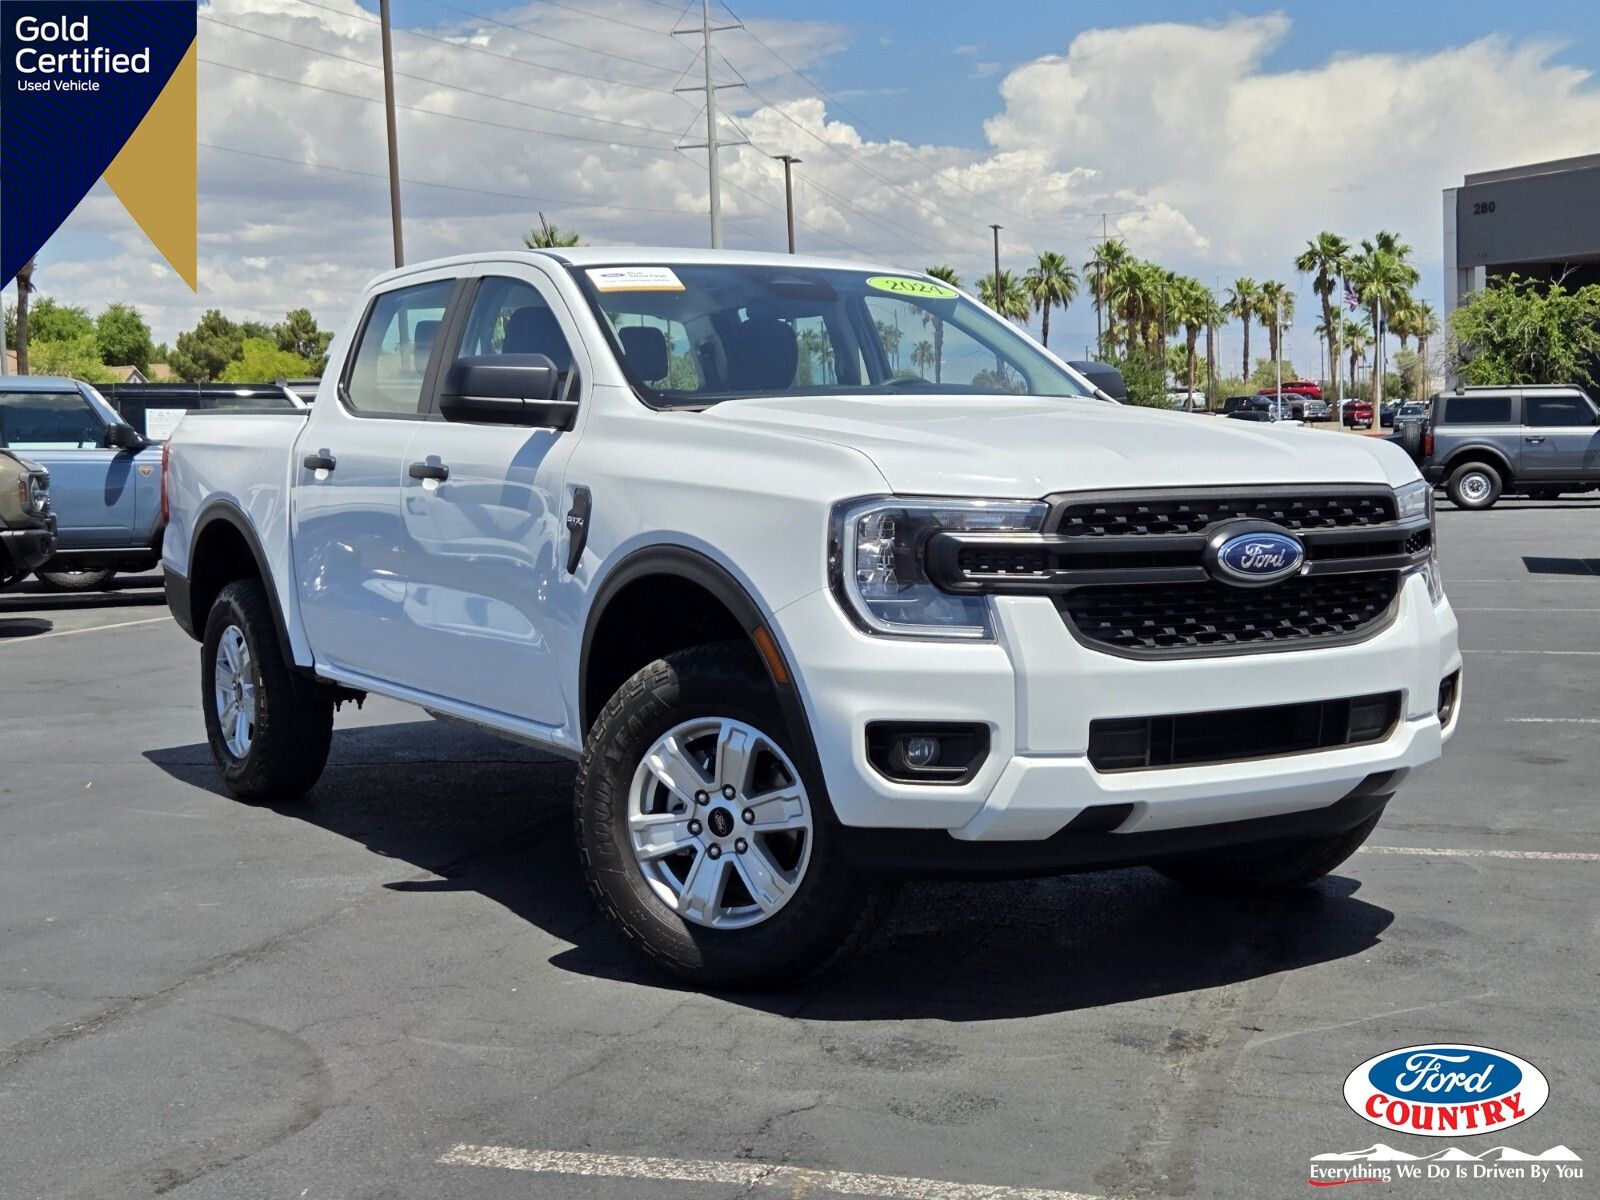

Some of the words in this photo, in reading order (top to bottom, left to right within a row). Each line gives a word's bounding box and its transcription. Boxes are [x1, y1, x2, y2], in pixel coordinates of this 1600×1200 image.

[1473, 201, 1496, 215] 280
[885, 279, 944, 295] 2024
[1240, 543, 1286, 569] Ford
